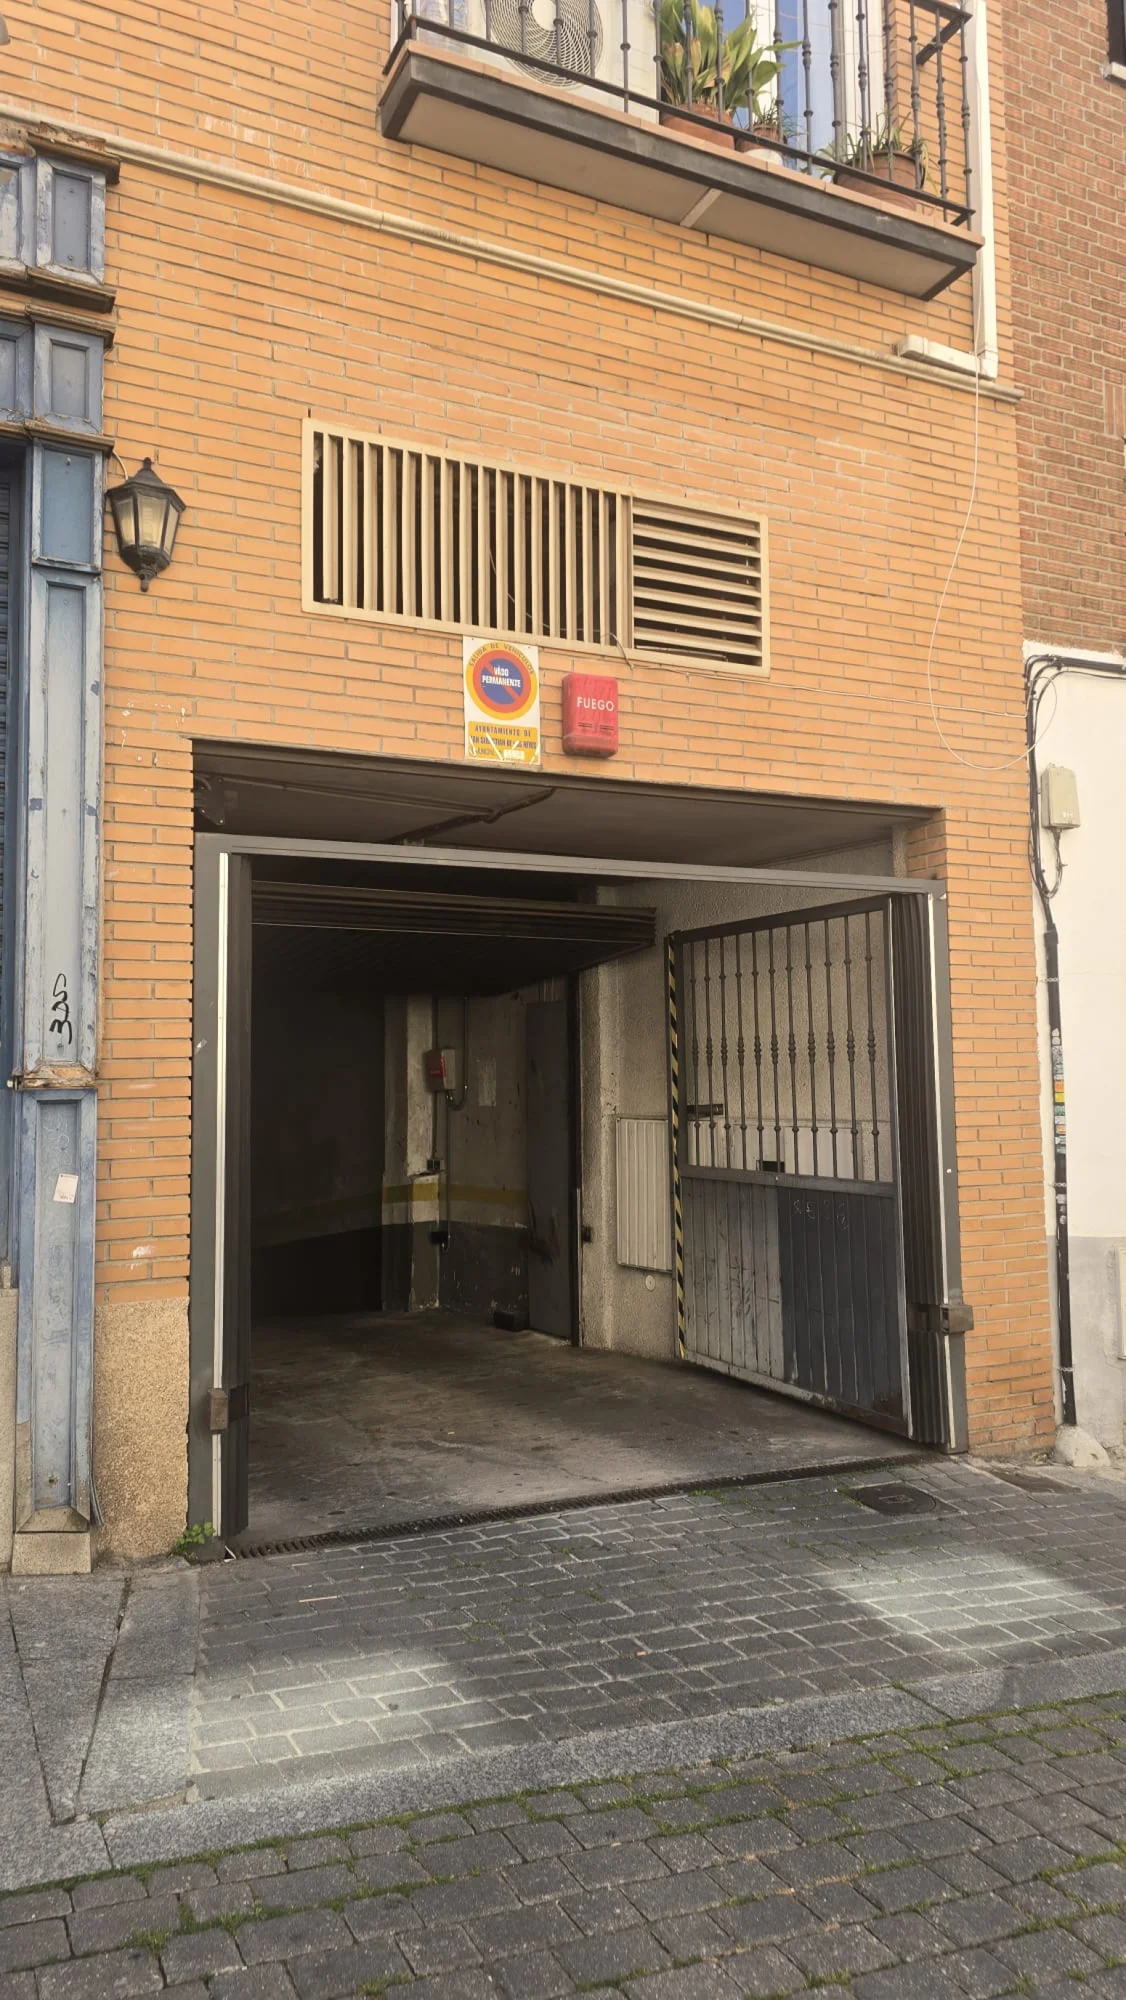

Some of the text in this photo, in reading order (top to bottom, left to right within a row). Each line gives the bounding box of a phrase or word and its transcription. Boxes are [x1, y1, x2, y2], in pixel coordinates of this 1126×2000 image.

[481, 674, 521, 687] PERMANENTE
[577, 696, 614, 712] FUEGO
[475, 725, 520, 736] AYUNTAMIENTO
